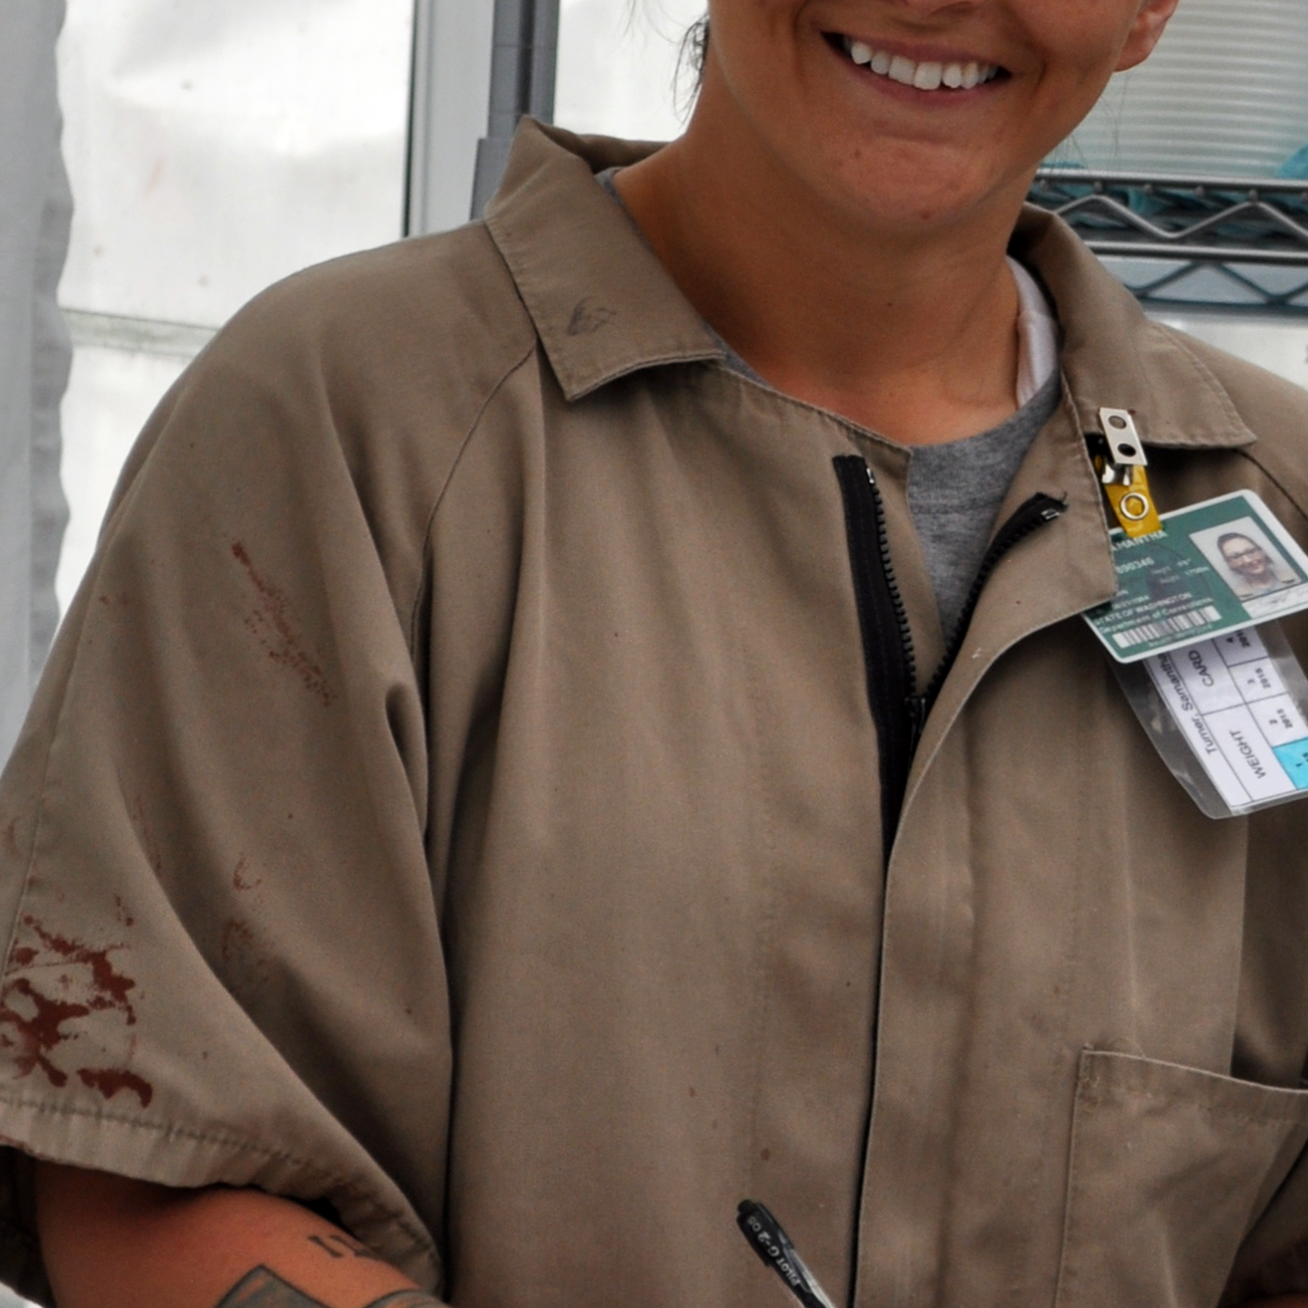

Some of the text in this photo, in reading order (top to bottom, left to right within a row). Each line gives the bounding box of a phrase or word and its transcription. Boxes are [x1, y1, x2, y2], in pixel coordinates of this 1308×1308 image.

[1135, 592, 1193, 613] WASHINGTON
[1097, 614, 1151, 633] Department
[1188, 649, 1215, 688] CARD
[1254, 666, 1273, 690] 2015
[1275, 707, 1295, 730] 2015
[1229, 728, 1267, 780] WEIGHT
[757, 1230, 780, 1258] G-2
[776, 1257, 801, 1287] PILOT
